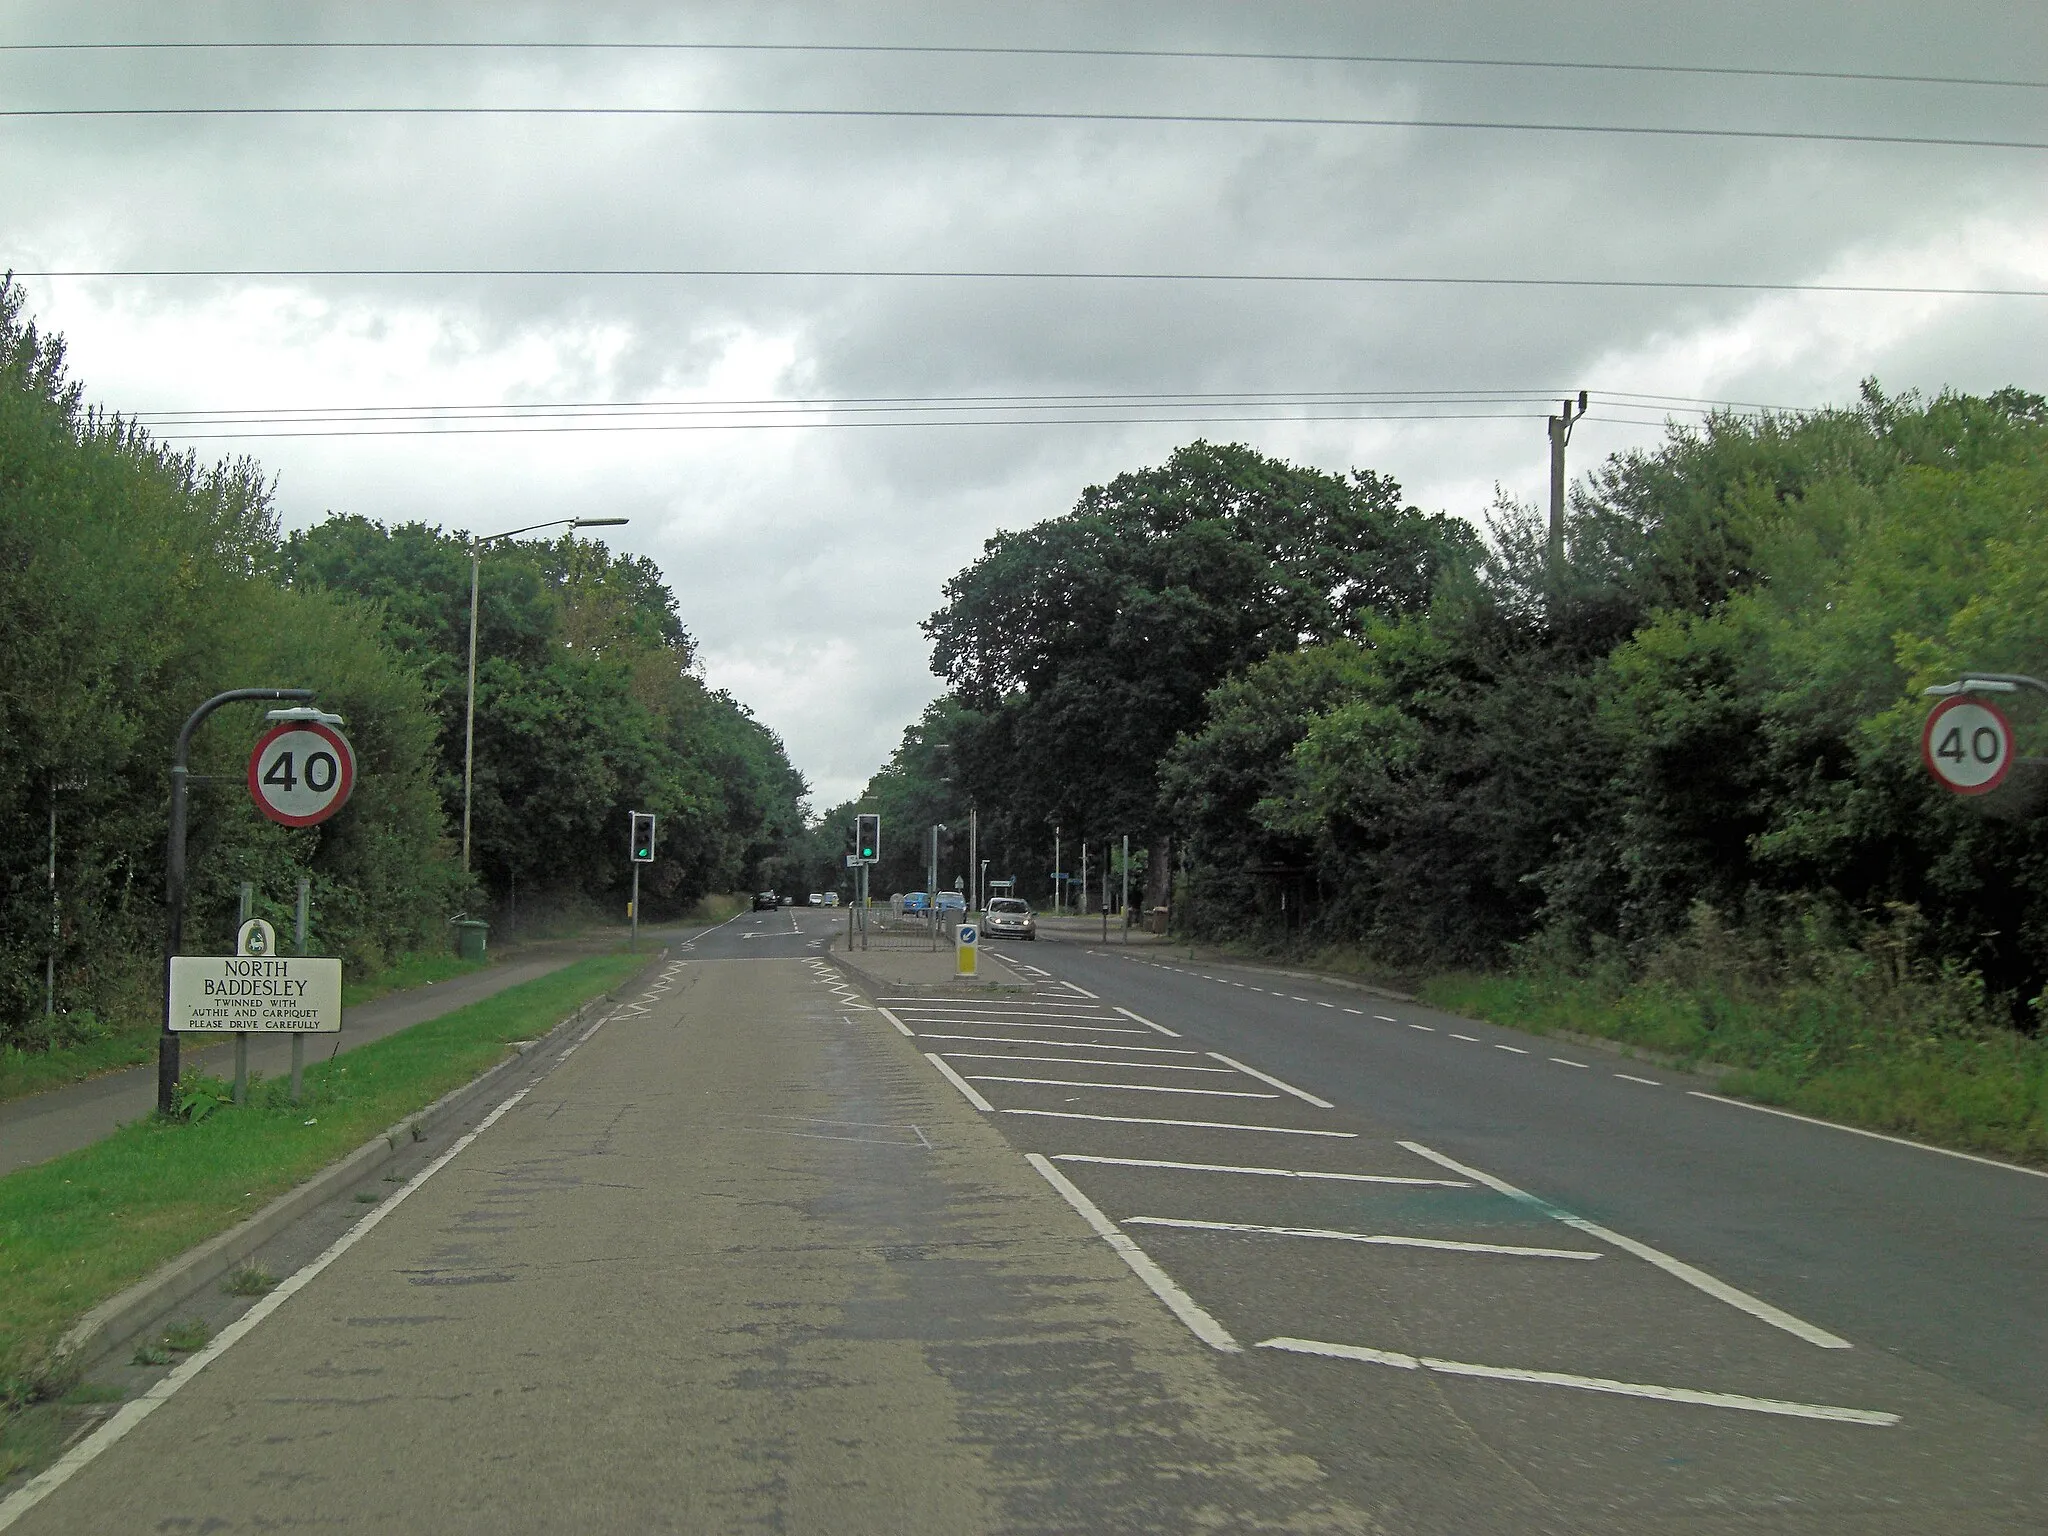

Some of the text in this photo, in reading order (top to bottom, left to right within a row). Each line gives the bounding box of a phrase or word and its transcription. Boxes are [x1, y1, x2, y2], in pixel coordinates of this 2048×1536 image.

[1937, 727, 1998, 764] 40
[263, 751, 337, 793] 40
[225, 961, 287, 977] NORTH
[204, 979, 308, 996] BADDESLEY
[214, 999, 296, 1008] TWINNED WITH
[192, 1009, 318, 1018] AUTHIE AND CARPIQUET
[190, 1020, 222, 1028] PLEASE
[265, 1021, 320, 1029] CAREFULLY
